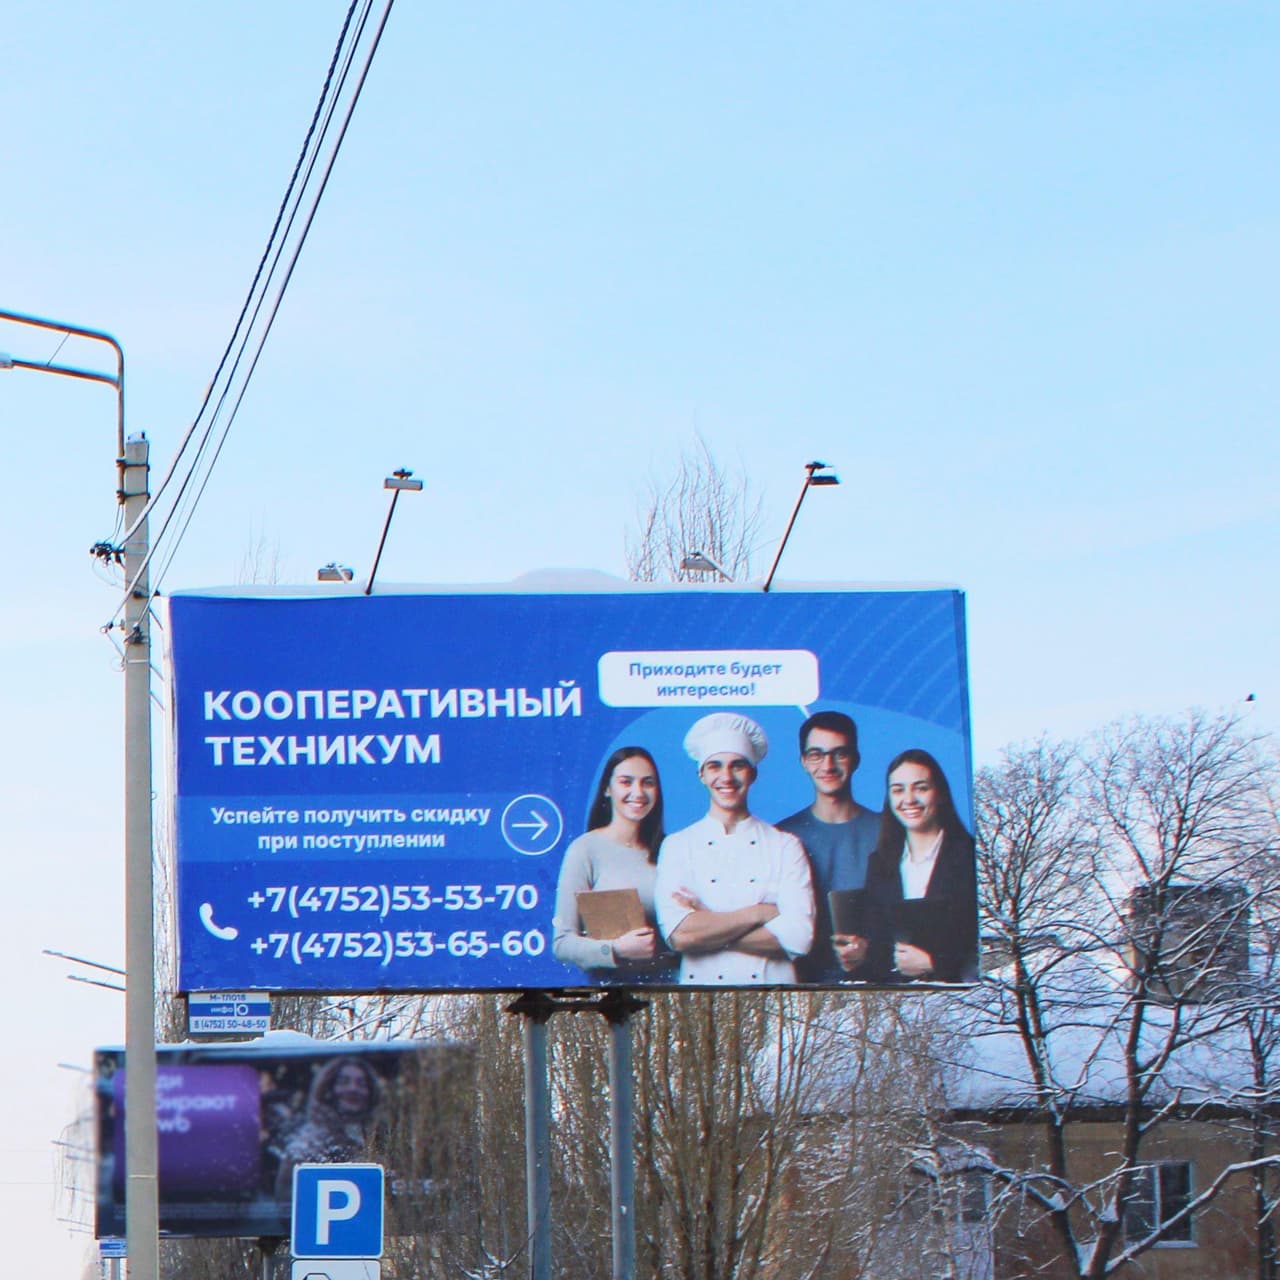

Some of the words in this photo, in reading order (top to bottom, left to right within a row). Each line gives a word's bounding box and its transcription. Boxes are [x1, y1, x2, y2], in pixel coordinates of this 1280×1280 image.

[629, 663, 727, 680] Приходите
[730, 662, 782, 677] будет
[204, 680, 582, 720] КООПЕРАТИВНЫЙ
[657, 683, 756, 699] интересно!
[204, 734, 441, 766] ТЕХНИКУМ
[211, 806, 300, 825] Успейте
[304, 807, 406, 827] получить
[410, 806, 491, 826] скидку
[258, 834, 298, 853] при
[303, 833, 445, 853] поступлении
[247, 884, 539, 918] +7(4752)53-53-70
[250, 929, 546, 965] +7(4752)53-65-60
